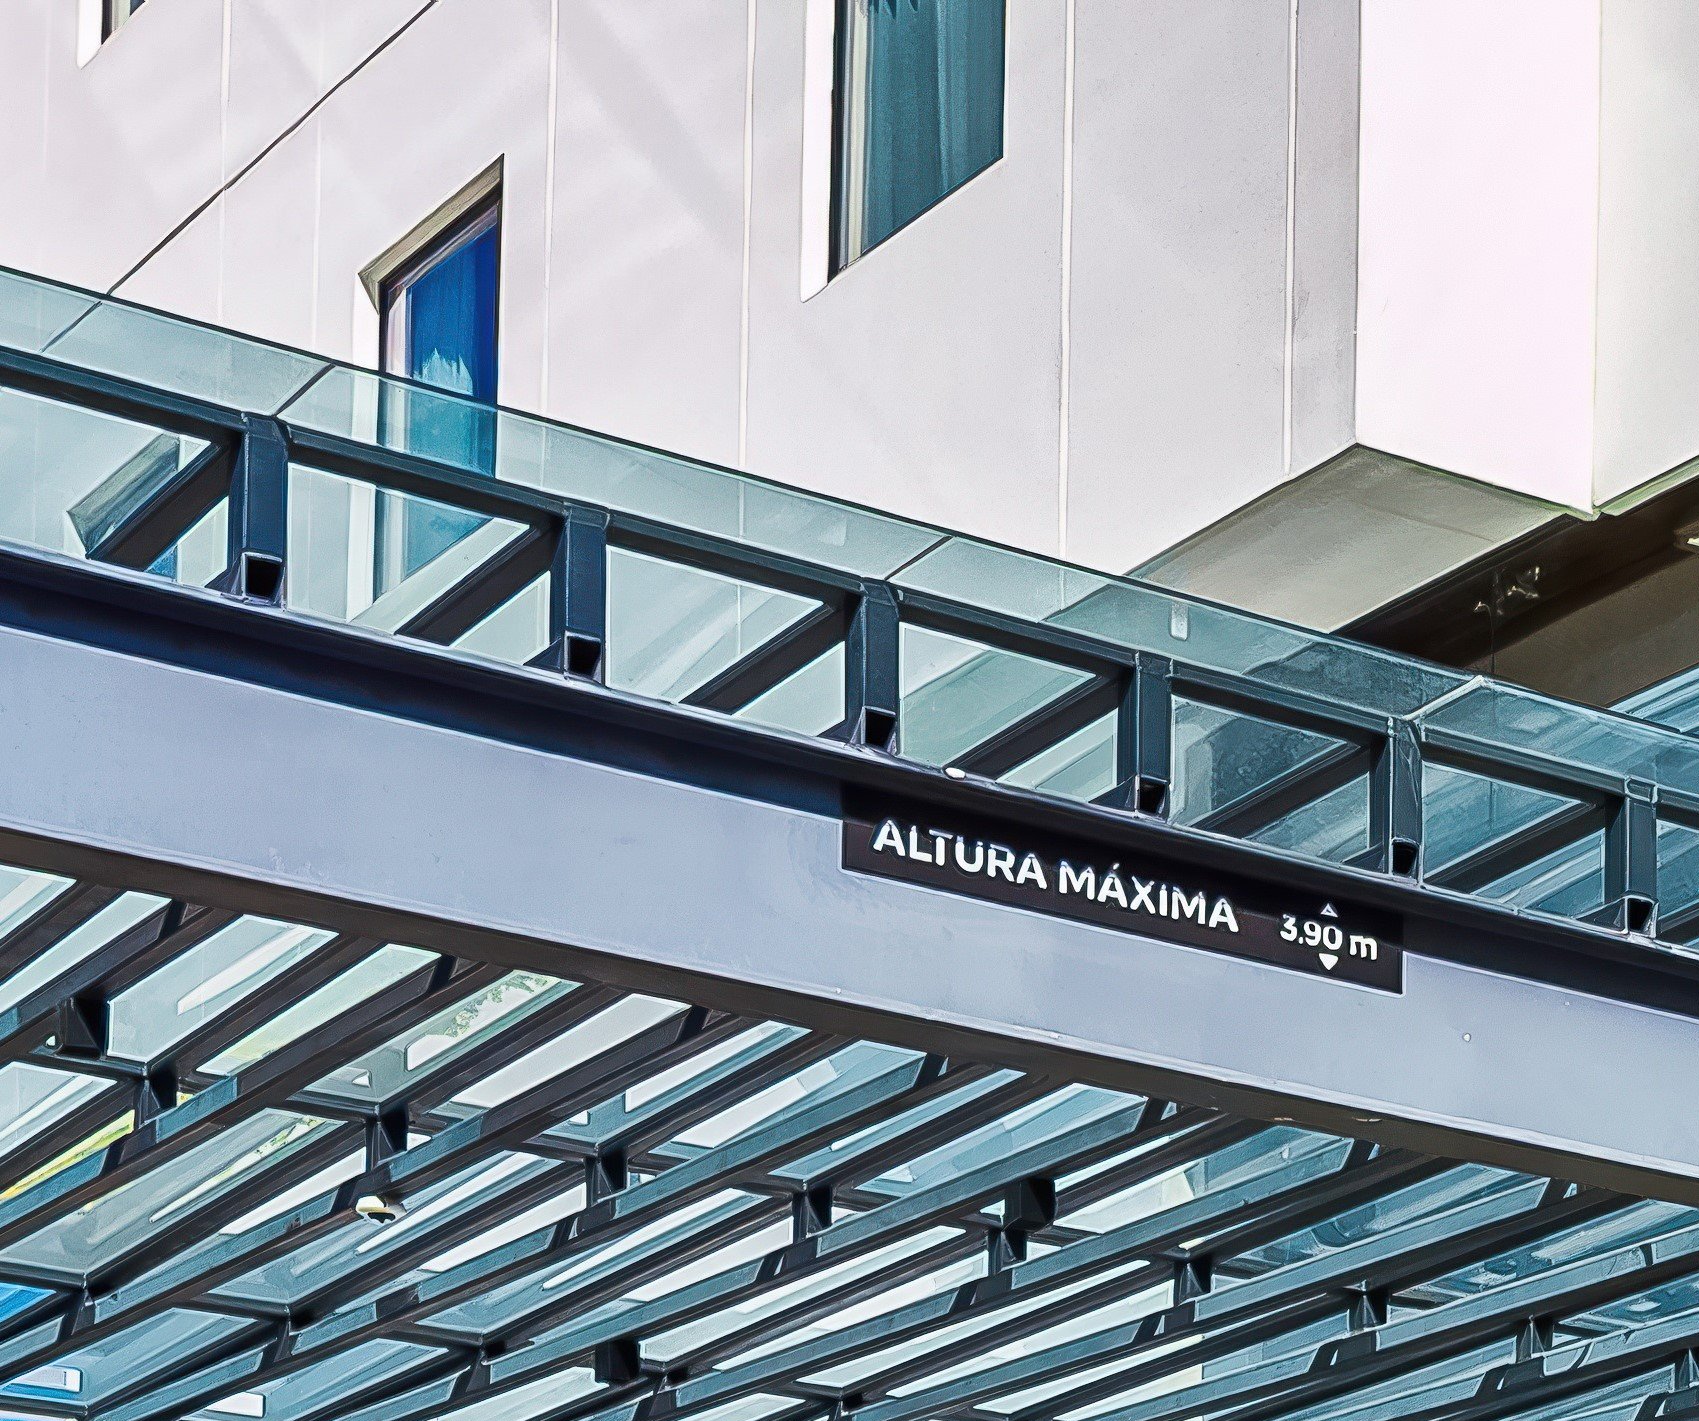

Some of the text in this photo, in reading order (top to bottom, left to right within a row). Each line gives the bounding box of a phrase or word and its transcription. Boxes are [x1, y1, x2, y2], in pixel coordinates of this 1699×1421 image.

[873, 819, 1378, 961] ALTURA MÁXIMA 3.90 m
